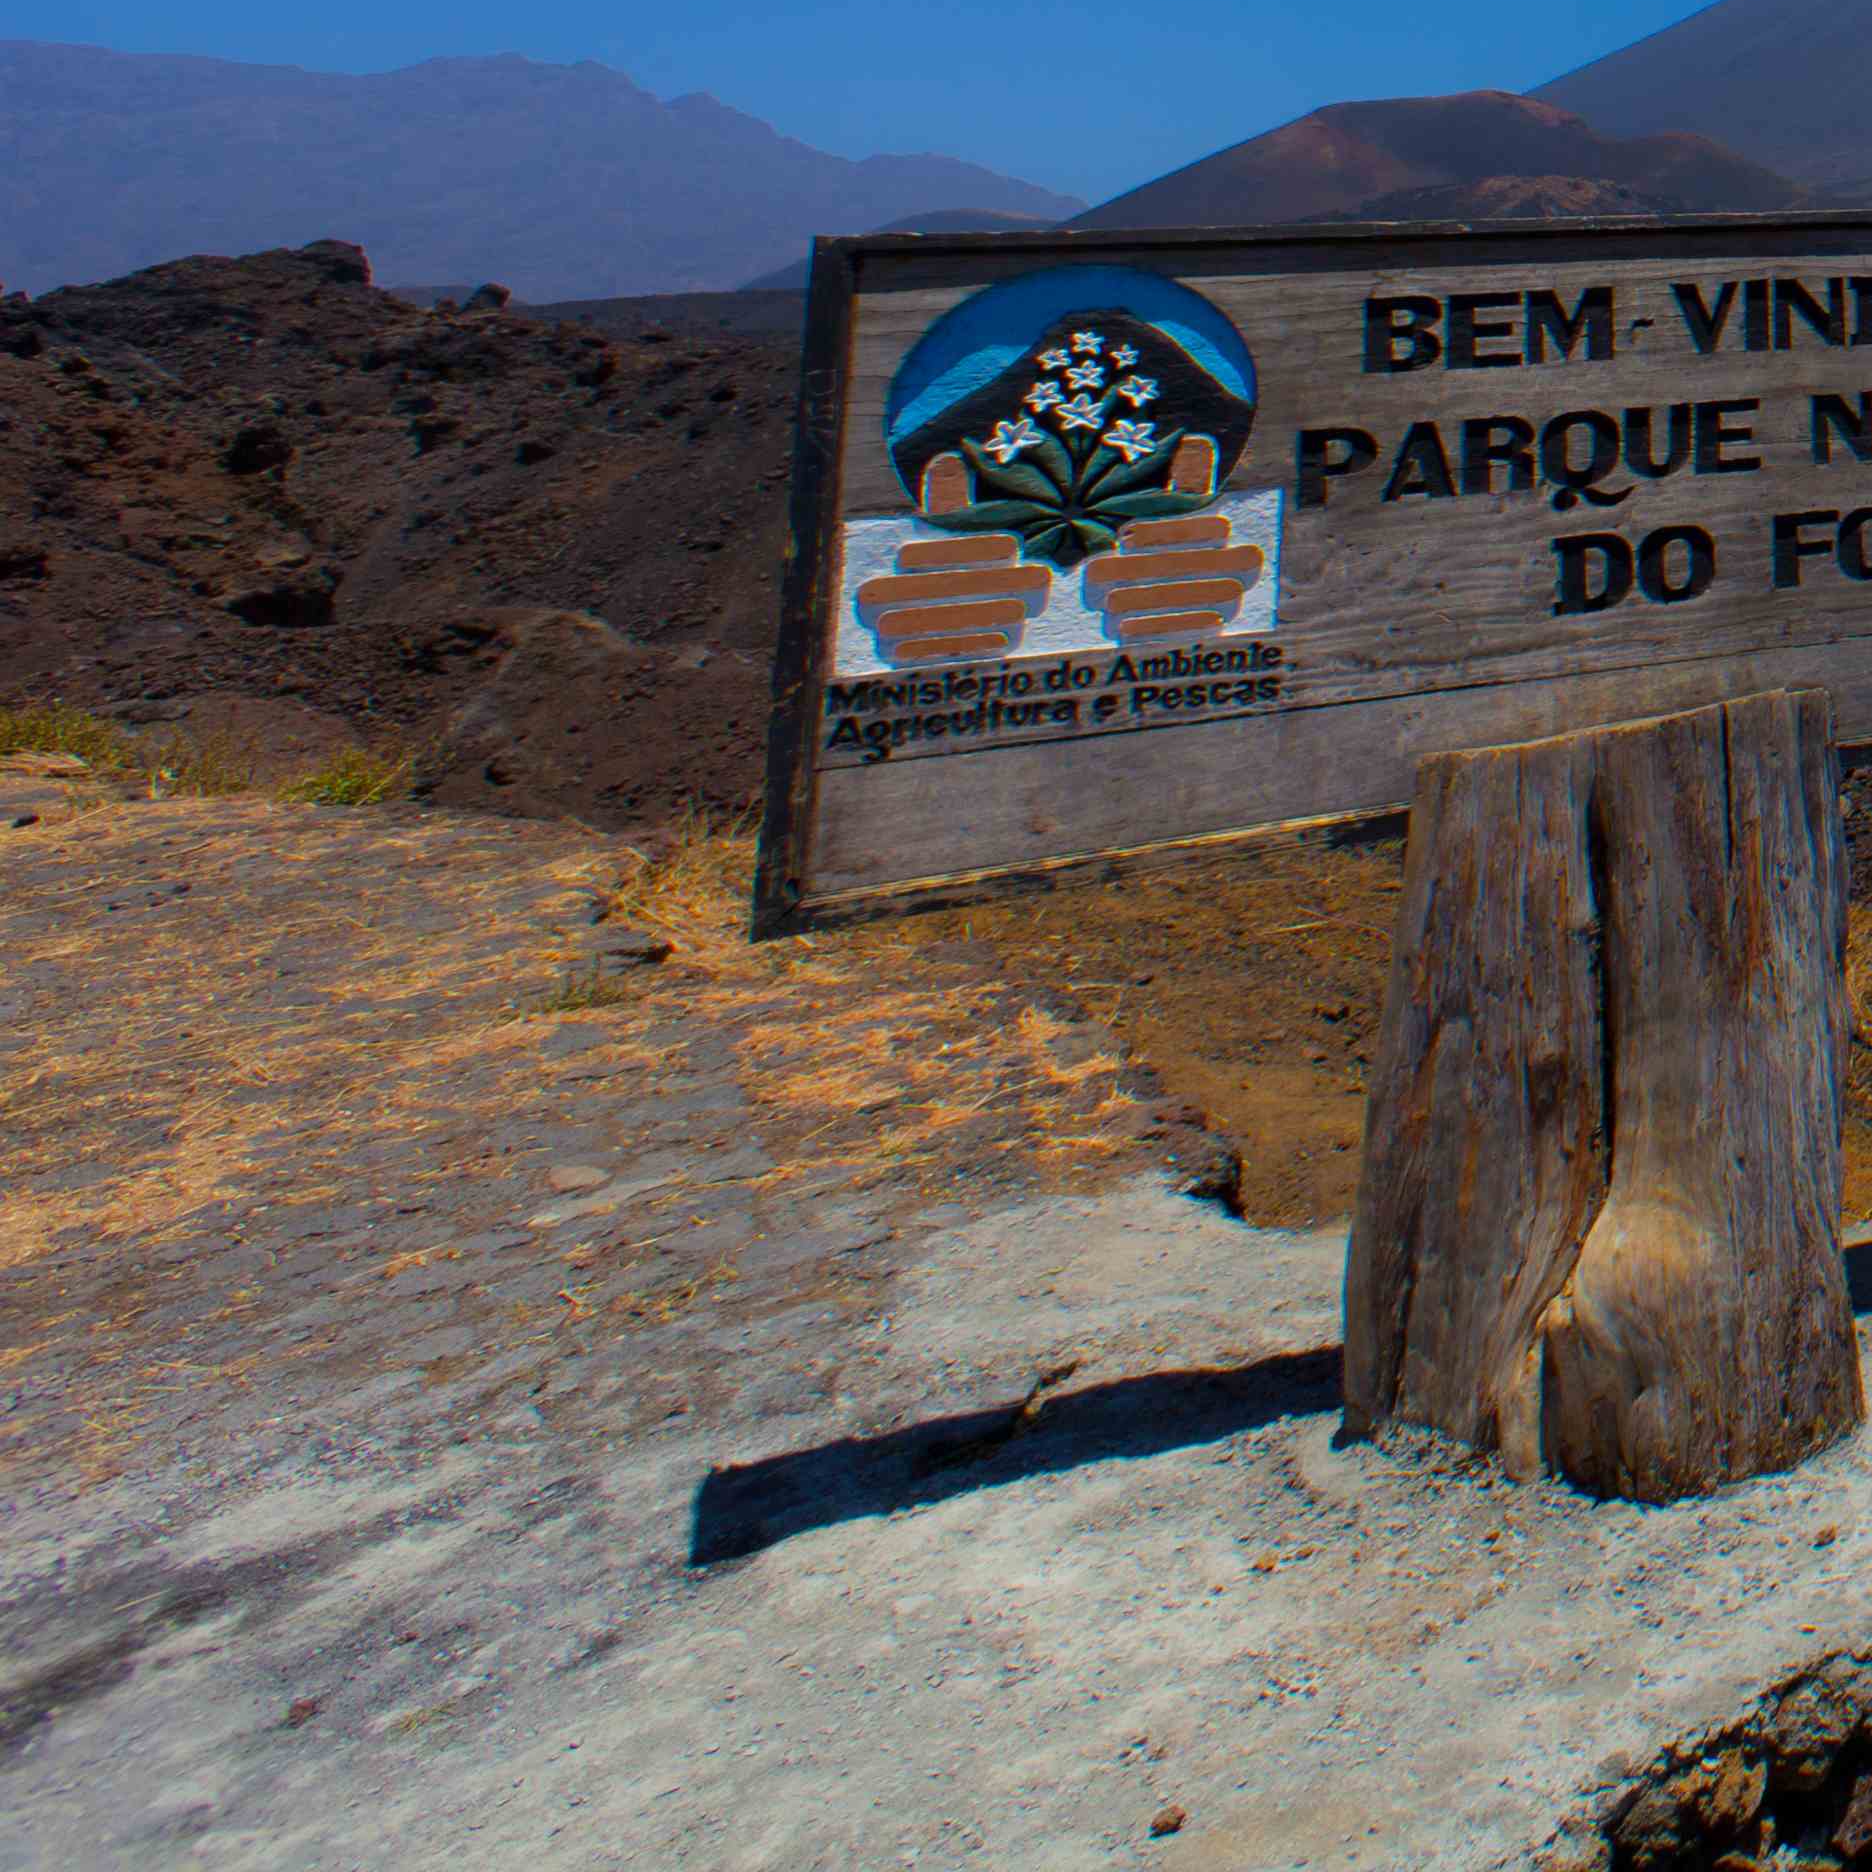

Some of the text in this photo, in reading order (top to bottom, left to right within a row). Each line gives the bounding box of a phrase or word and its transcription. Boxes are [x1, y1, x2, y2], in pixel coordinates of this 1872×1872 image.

[1296, 398, 1762, 512] PARQUE
[1551, 525, 1716, 617] DO
[825, 696, 1081, 763] Agricultura
[1091, 693, 1120, 721] e
[826, 662, 1034, 716] Ministério
[1044, 659, 1096, 691] do
